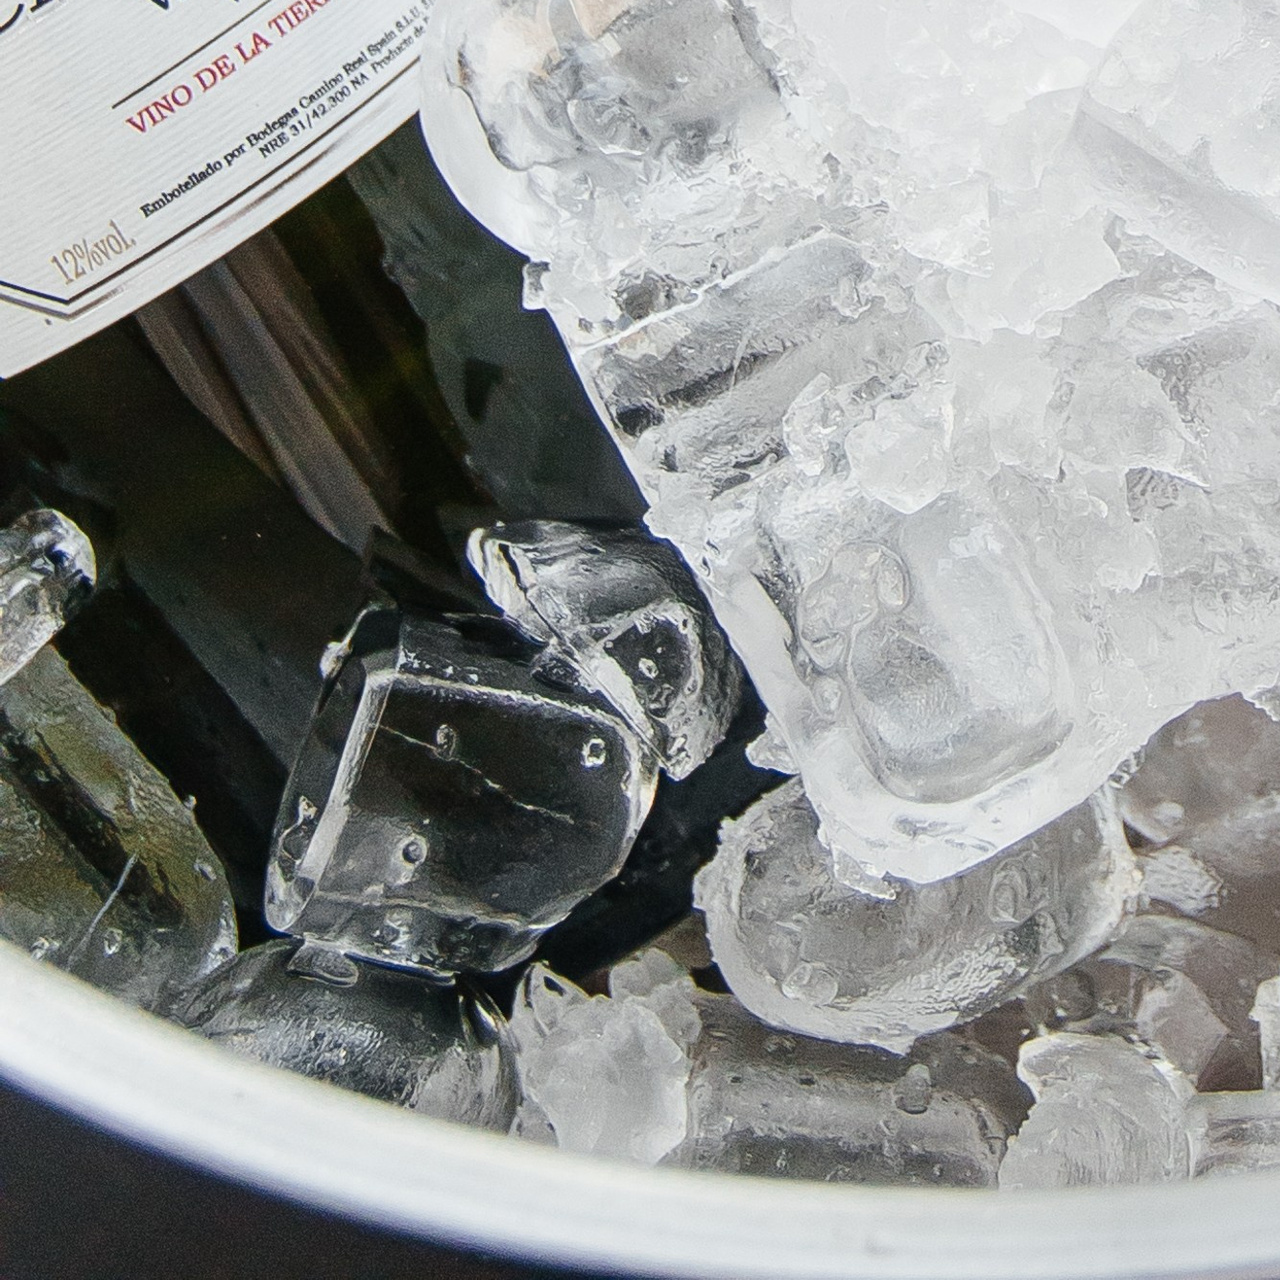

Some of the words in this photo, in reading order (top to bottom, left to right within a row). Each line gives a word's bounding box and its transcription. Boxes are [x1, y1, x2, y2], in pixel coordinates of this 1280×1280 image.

[125, 84, 193, 134] VINO
[193, 54, 236, 93] DE
[234, 32, 272, 65] LA
[140, 159, 223, 218] Embotellado
[223, 143, 247, 166] por
[299, 73, 345, 109] Camino
[343, 51, 368, 76] Real
[258, 131, 290, 159] NRE
[350, 72, 370, 91] NA
[371, 36, 414, 74] Producto
